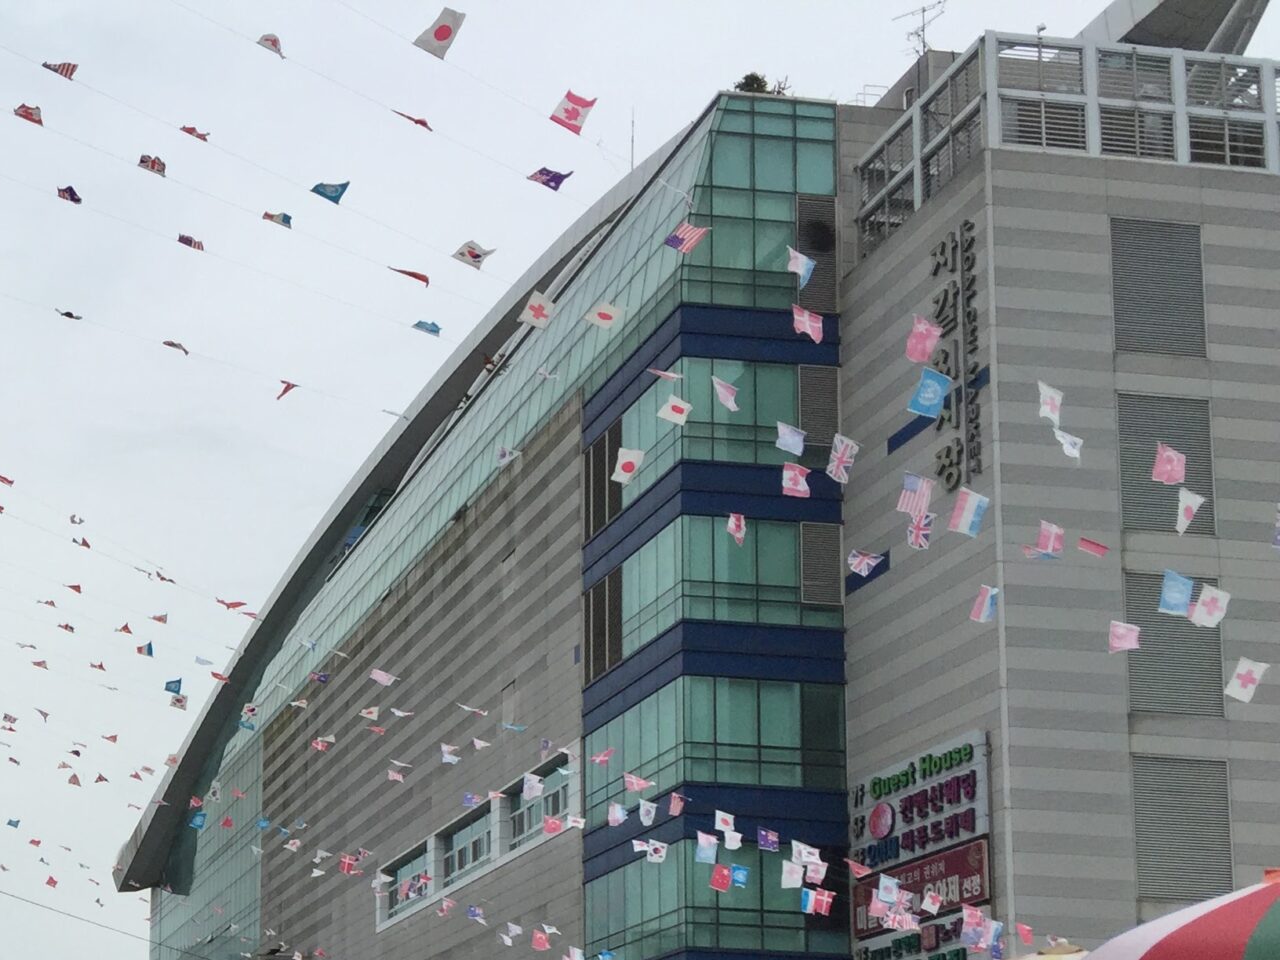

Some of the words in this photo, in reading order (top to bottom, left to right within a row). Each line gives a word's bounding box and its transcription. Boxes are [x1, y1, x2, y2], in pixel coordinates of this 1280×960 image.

[930, 230, 962, 493] 자갈치시장
[869, 762, 917, 800] Guest
[919, 743, 974, 780] House
[961, 873, 981, 897] 선정
